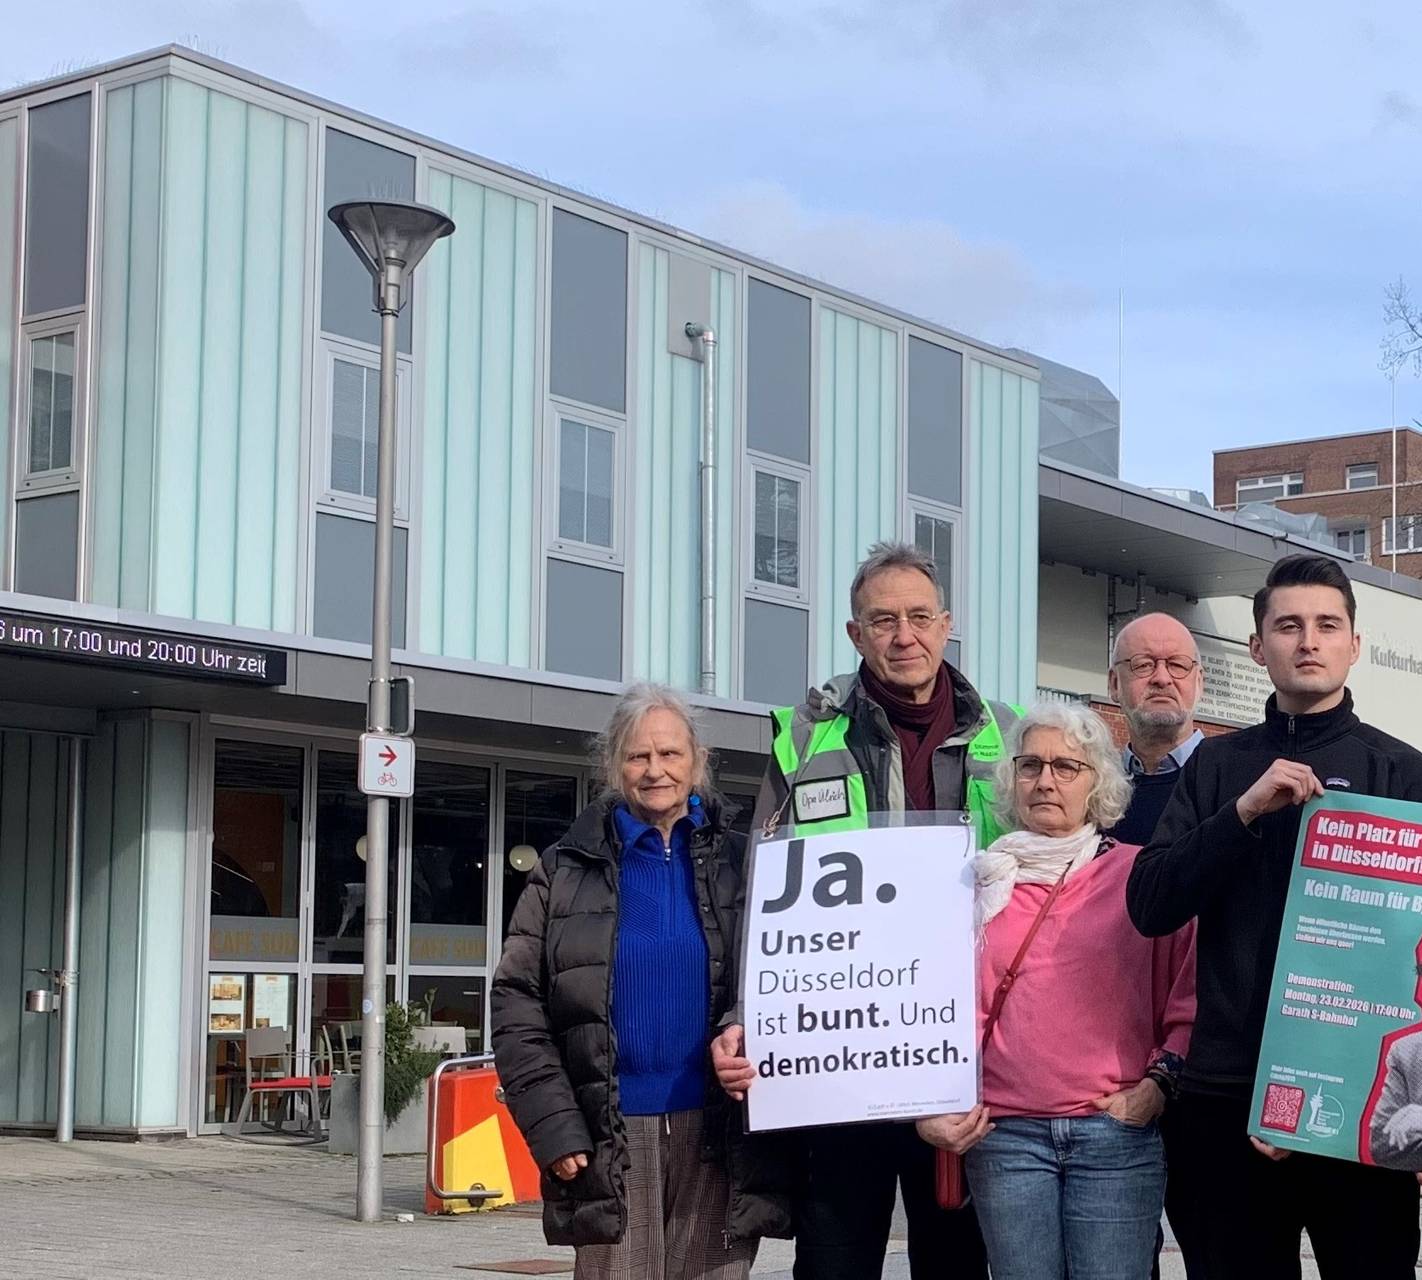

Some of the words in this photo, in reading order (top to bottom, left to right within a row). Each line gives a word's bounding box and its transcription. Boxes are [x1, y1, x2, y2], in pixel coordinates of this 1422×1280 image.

[12, 626, 43, 646] um
[51, 627, 101, 653] 17:00
[108, 638, 141, 658] und
[148, 640, 195, 665] 20:00
[202, 641, 233, 669] Uhr
[1316, 817, 1354, 840] Kein
[1356, 822, 1395, 845] Platz
[1397, 828, 1421, 849] für
[1312, 840, 1329, 860] in
[761, 838, 898, 914] Ja.
[1304, 879, 1339, 900] Kein
[1341, 883, 1385, 907] Raum
[1386, 891, 1411, 911] für
[760, 929, 862, 956] Unser
[758, 958, 921, 995] Düsseldorf
[1287, 972, 1355, 994] Demonstration:
[757, 1012, 788, 1036] ist
[797, 1002, 890, 1033] bunt.
[900, 998, 956, 1026] Und
[1281, 1004, 1310, 1019] Garath
[1311, 1009, 1359, 1027] S-Bahnhof
[1284, 988, 1319, 1003] Montag,
[1319, 994, 1370, 1012] 23.02.2026
[1375, 1004, 1399, 1017] 17:00
[1399, 1007, 1417, 1021] Uhr
[758, 1040, 969, 1079] demokratisch.
